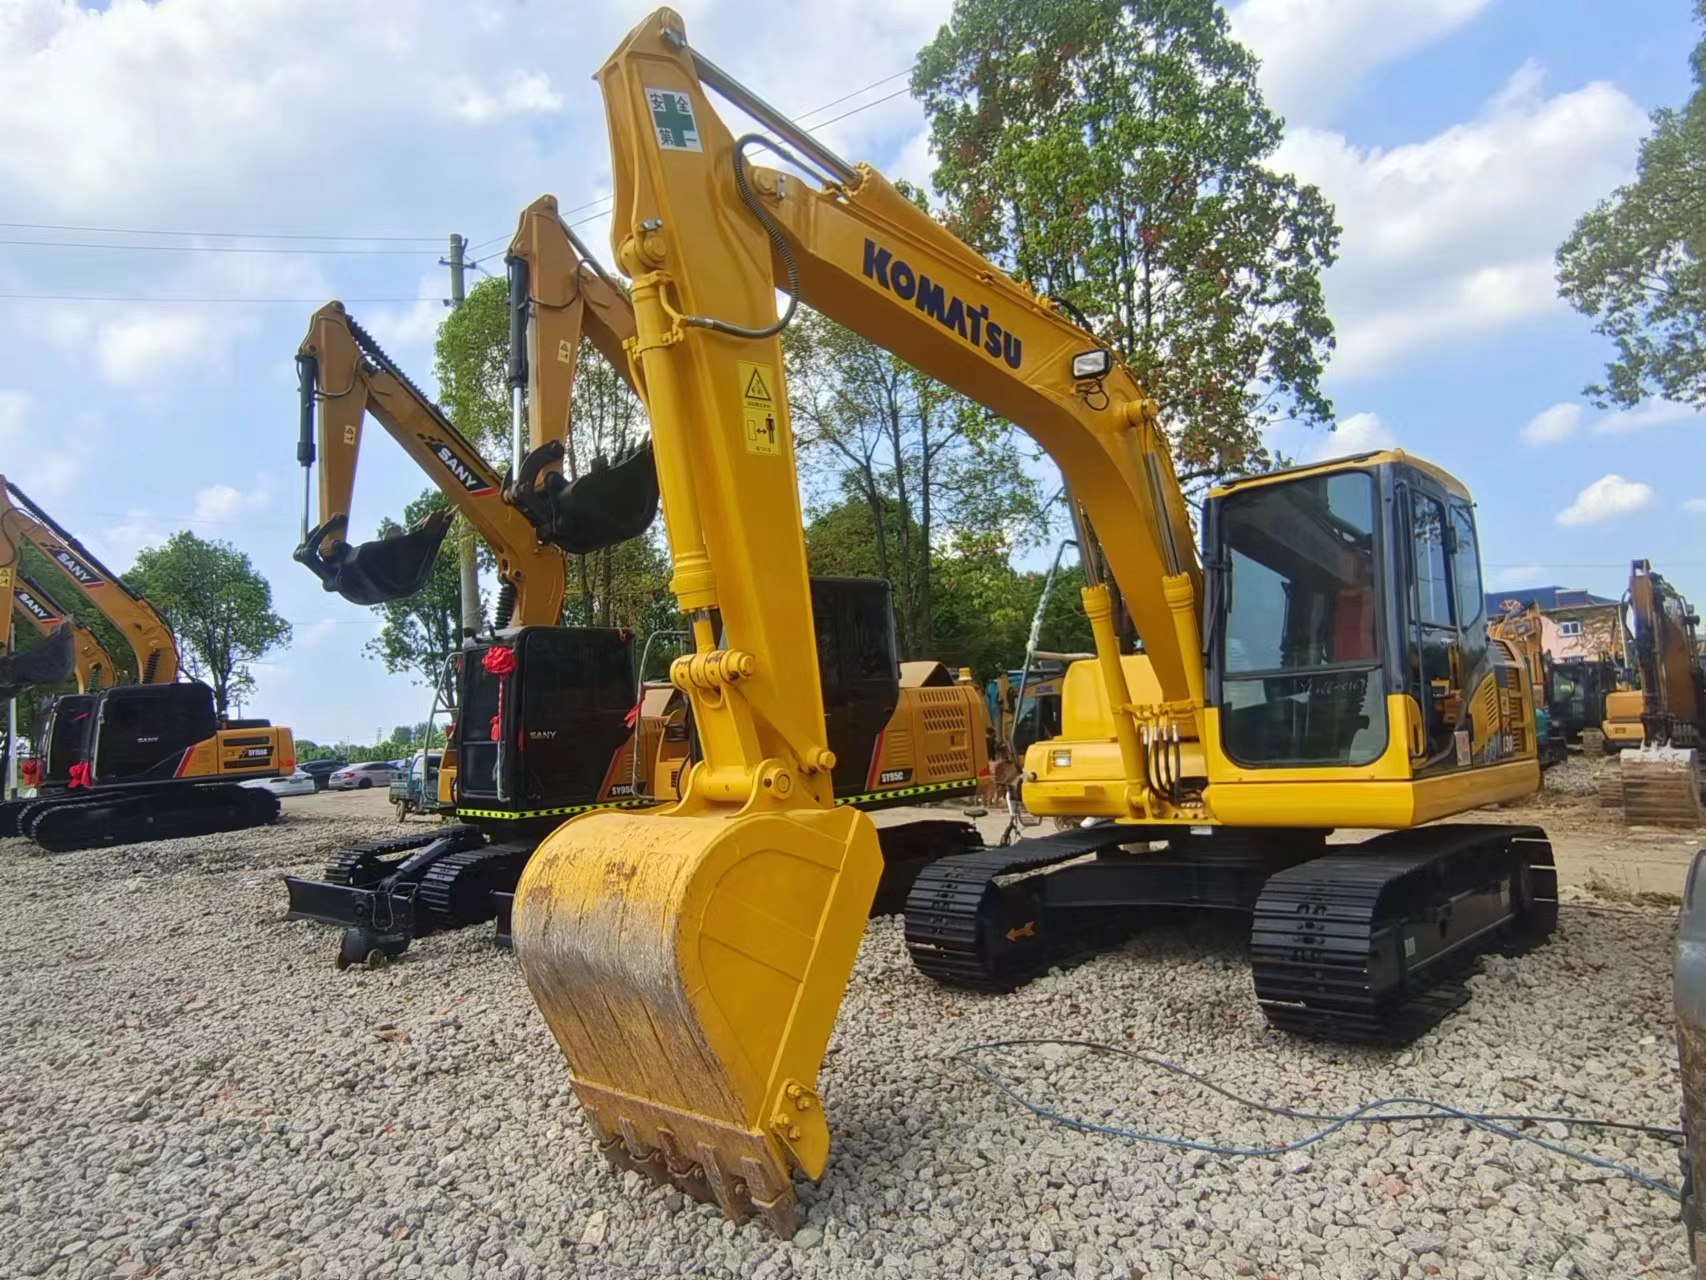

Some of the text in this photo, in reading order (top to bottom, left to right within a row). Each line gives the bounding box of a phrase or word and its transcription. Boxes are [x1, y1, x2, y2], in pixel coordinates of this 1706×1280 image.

[650, 92, 690, 113] 安全
[659, 129, 697, 146] 第一
[863, 238, 1022, 370] KOMATSU
[438, 447, 478, 487] SANY
[57, 552, 92, 581] SANY
[18, 593, 48, 617] SANY
[529, 731, 557, 740] SANY
